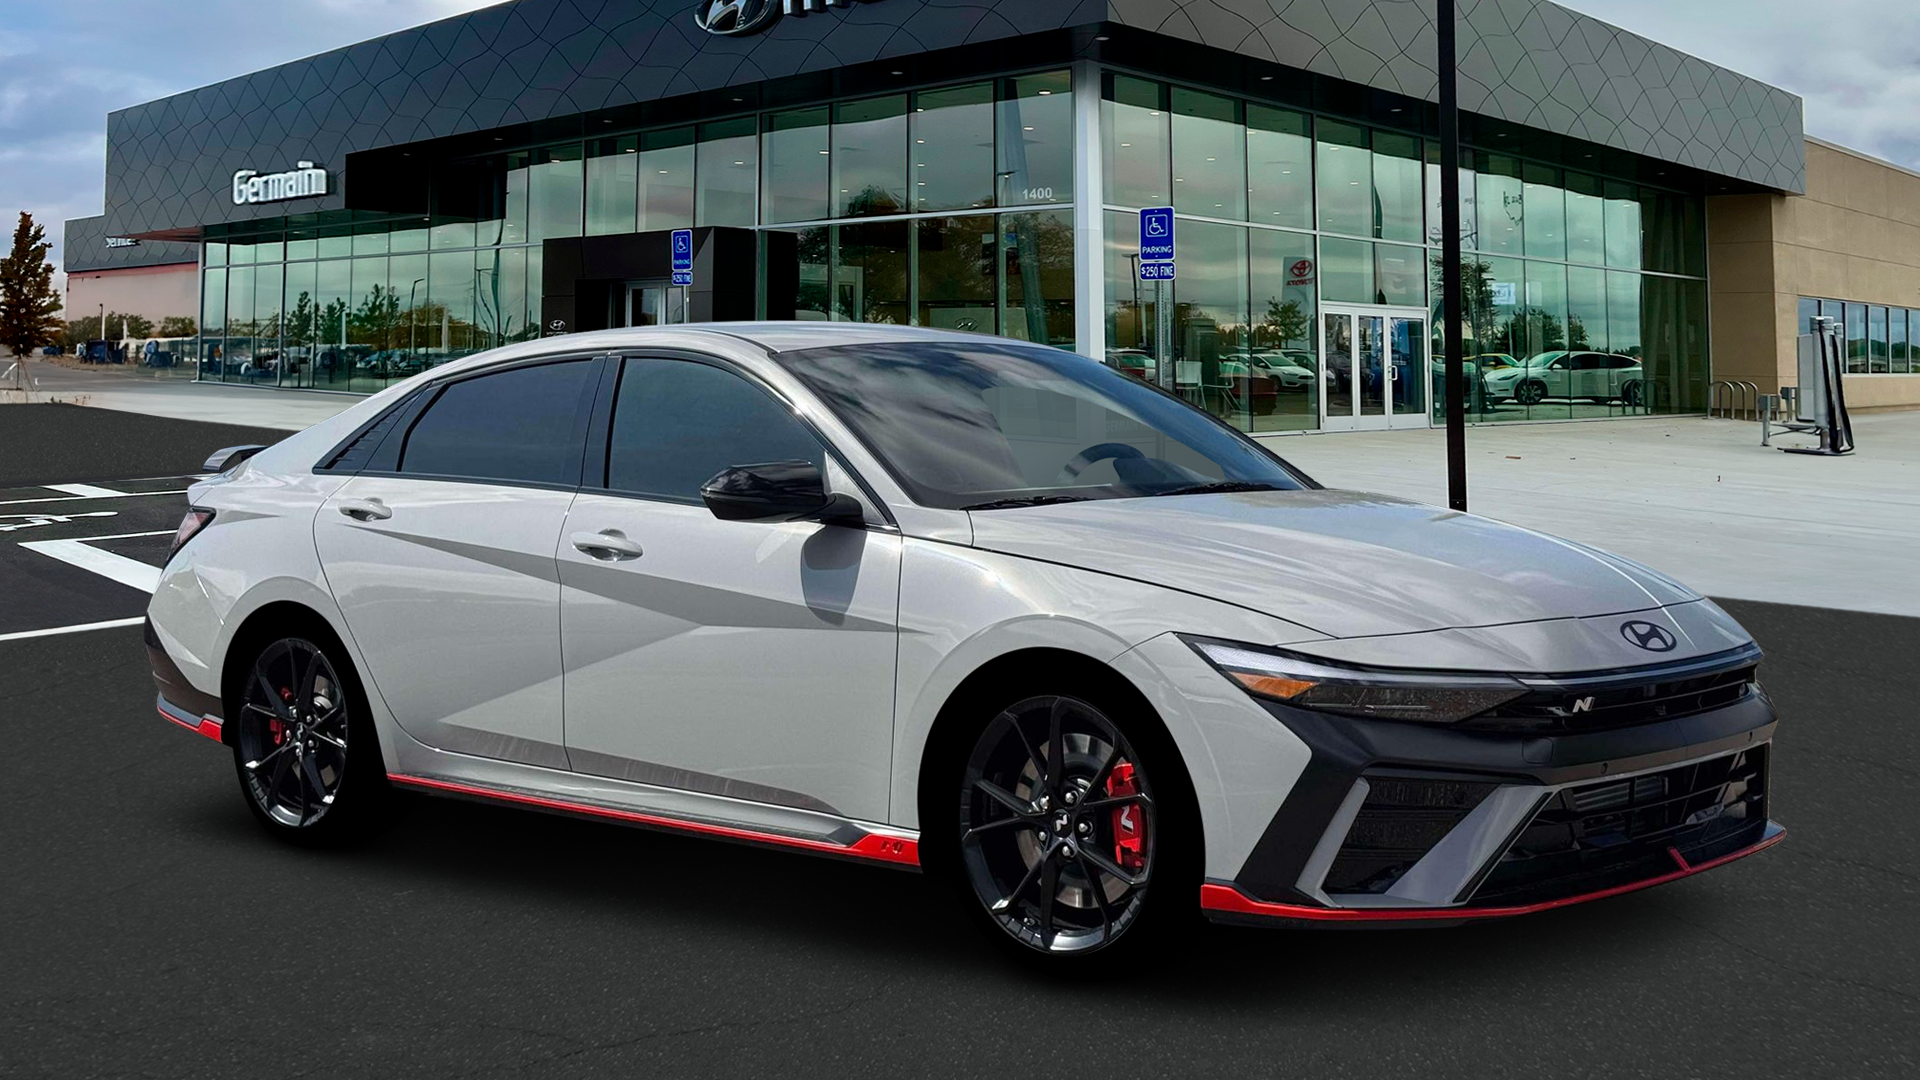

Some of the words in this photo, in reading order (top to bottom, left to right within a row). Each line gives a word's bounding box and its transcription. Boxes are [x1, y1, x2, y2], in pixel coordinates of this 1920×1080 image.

[233, 160, 327, 204] Germain
[1022, 187, 1053, 200] 1400
[1142, 245, 1172, 254] PARKING
[1141, 266, 1159, 277] $250
[1160, 266, 1174, 277] FINE
[1572, 697, 1595, 713] N
